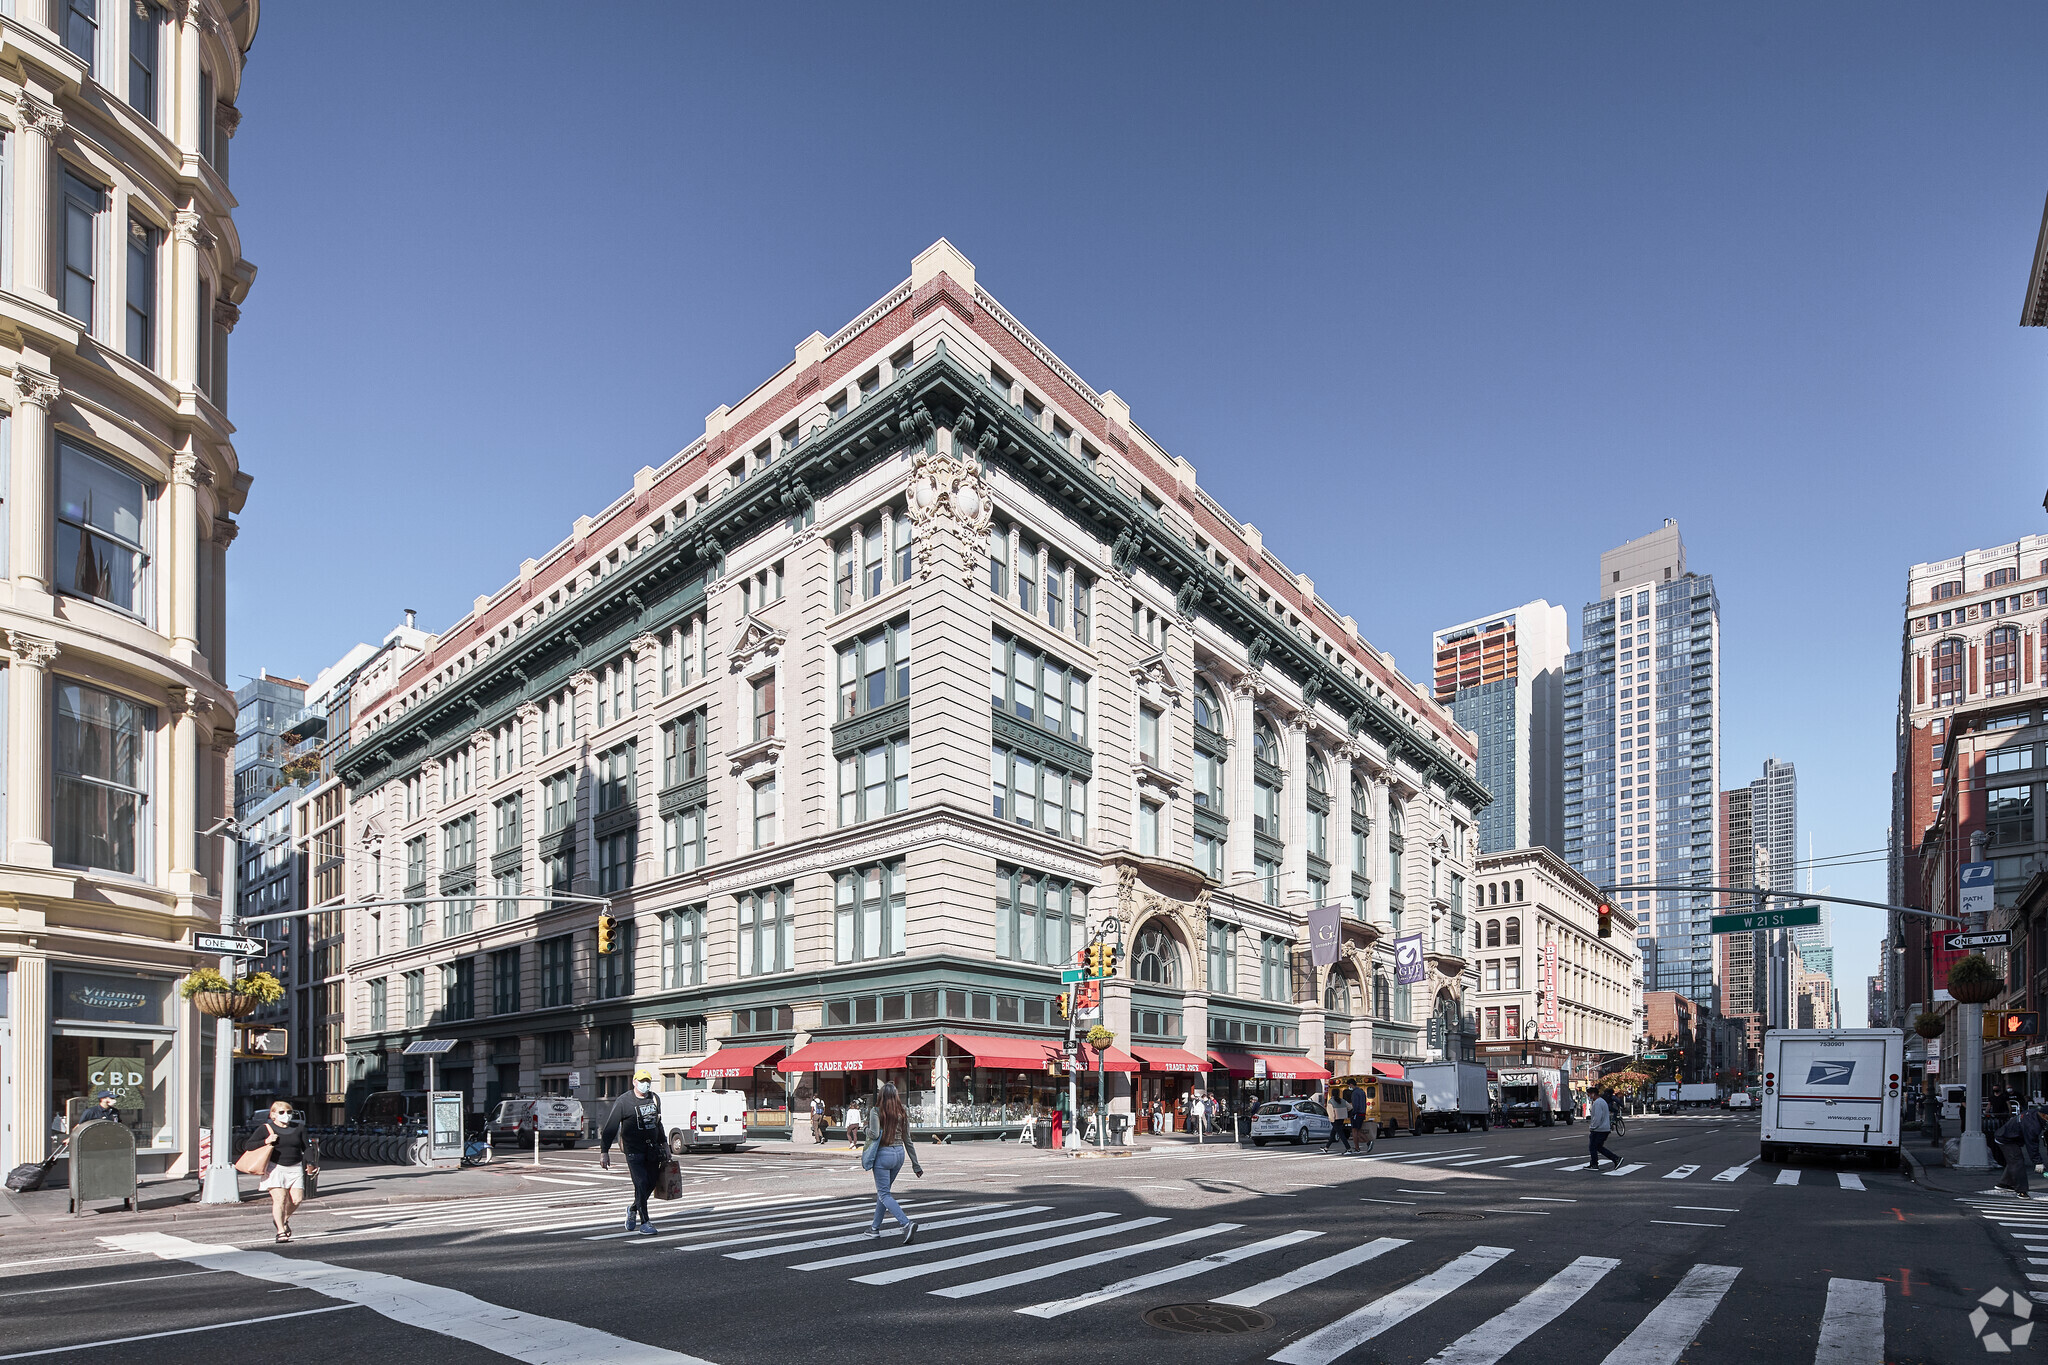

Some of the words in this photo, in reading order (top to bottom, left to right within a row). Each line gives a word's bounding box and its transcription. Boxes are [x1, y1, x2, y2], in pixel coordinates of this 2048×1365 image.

[1743, 917, 1753, 927] W
[1757, 916, 1768, 927] 21
[1773, 914, 1784, 925] St
[204, 938, 226, 948] ONE
[235, 942, 256, 951] WAY
[1954, 938, 1973, 946] ONE
[1982, 935, 2002, 943] WAY
[1400, 964, 1421, 977] GFP
[1546, 946, 1555, 1022] Burlington
[83, 986, 146, 1000] Vitamin
[79, 996, 138, 1008] Shoppe
[814, 1061, 842, 1071] TRADER
[844, 1060, 864, 1070] JOE'S
[1165, 1063, 1186, 1071] TRADER
[1186, 1064, 1199, 1072] JOE'S
[91, 1071, 143, 1086] CBD
[700, 1068, 724, 1078] TRADER
[724, 1067, 740, 1077] JOE'S
